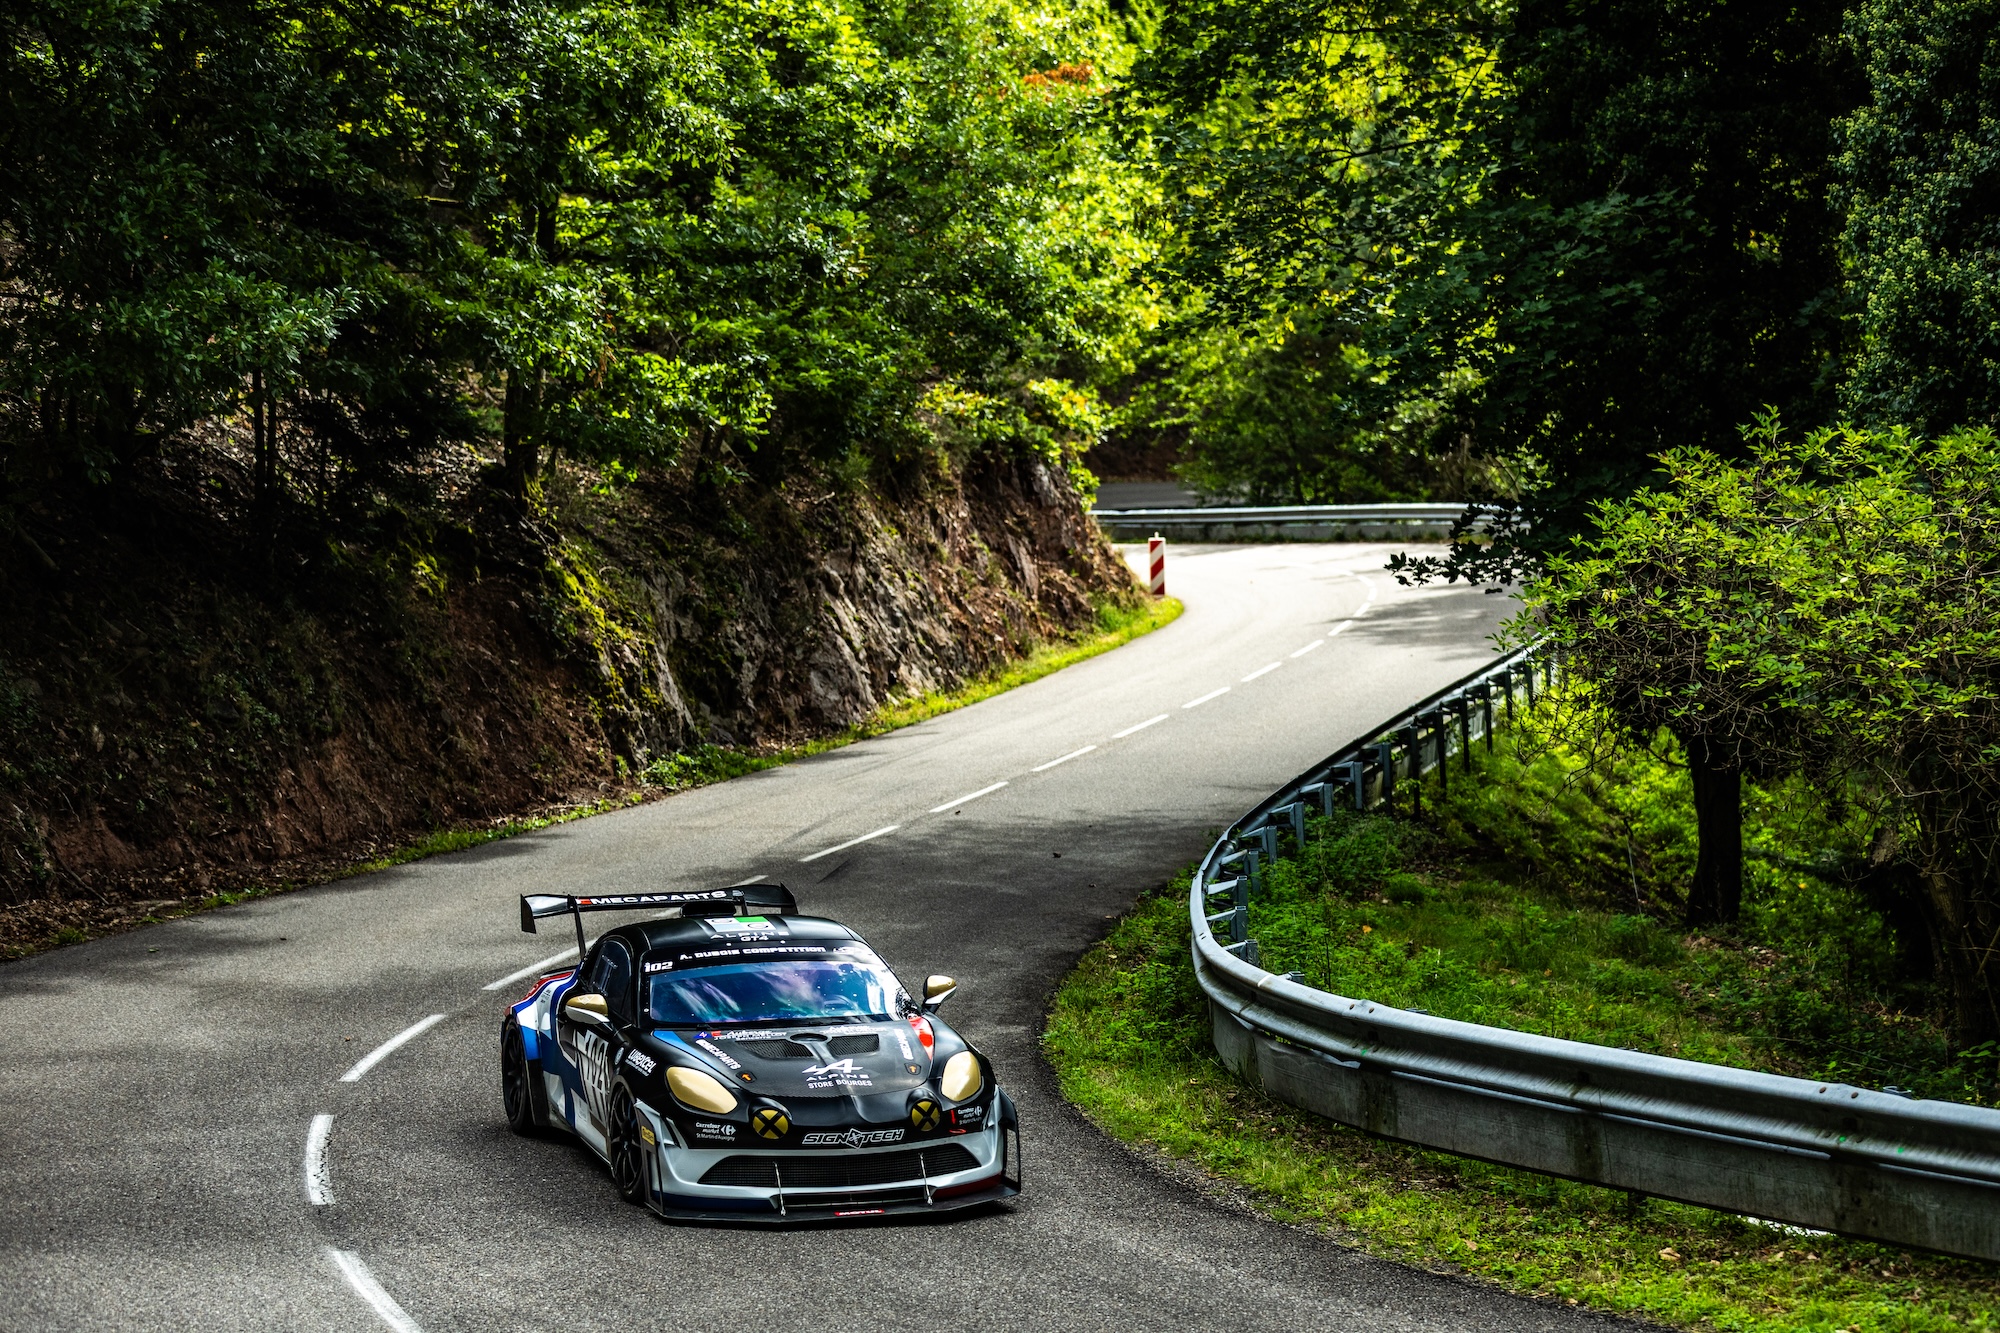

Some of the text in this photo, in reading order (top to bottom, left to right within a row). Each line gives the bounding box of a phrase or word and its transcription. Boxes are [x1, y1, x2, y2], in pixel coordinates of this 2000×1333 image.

[590, 890, 727, 905] MECAPARTS
[710, 931, 790, 939] ALPINE
[742, 946, 827, 954] COMPETITION
[644, 961, 673, 973] 102
[806, 1073, 870, 1082] ALPINE
[808, 1079, 873, 1089] STORE BOURGES
